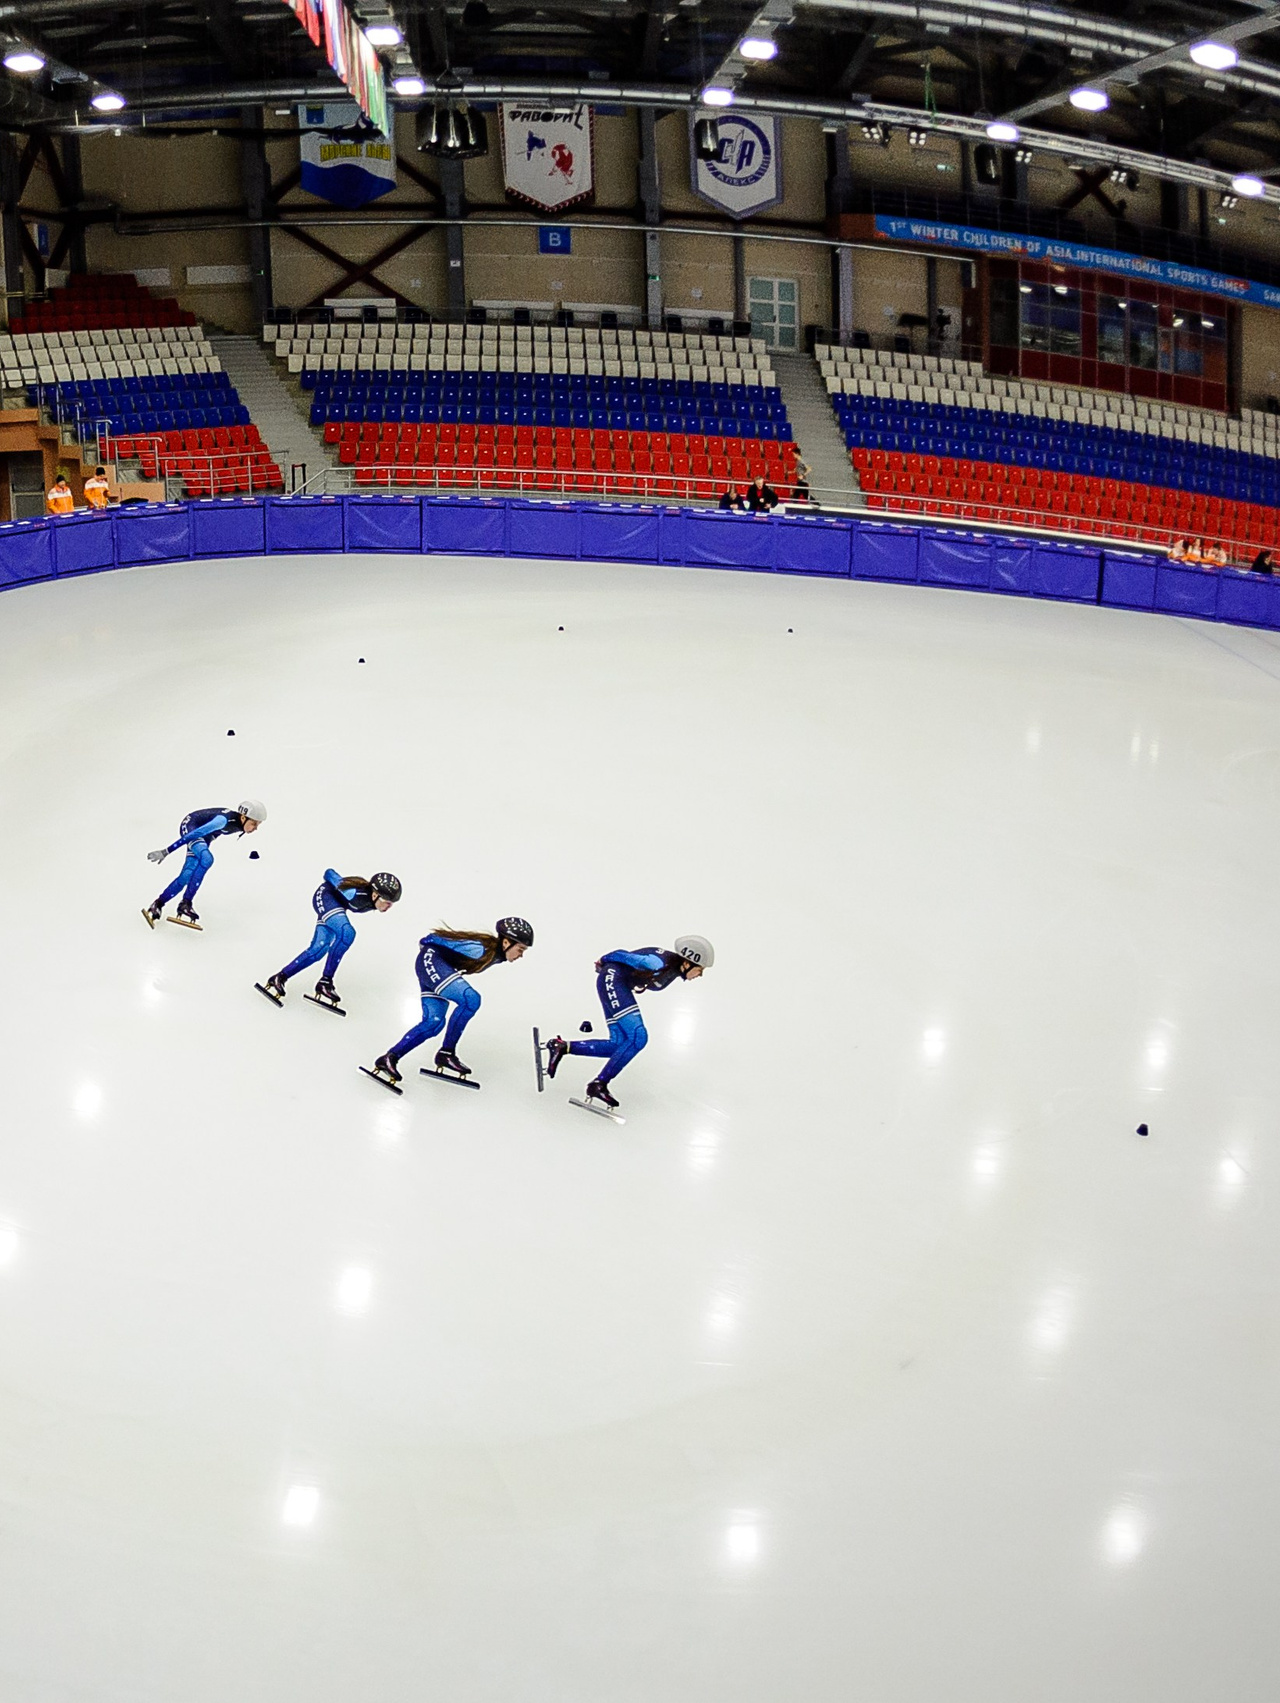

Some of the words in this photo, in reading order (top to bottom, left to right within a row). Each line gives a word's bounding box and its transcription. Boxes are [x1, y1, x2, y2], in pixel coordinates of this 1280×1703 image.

[910, 223, 959, 240] WINTER
[963, 231, 1021, 250] CHILDREN
[1026, 240, 1041, 253] OF
[1046, 245, 1071, 259] ASIA
[1075, 250, 1164, 276] INTERNATIONAL
[1167, 267, 1207, 285] SPORTS
[1211, 276, 1246, 294] GAMES
[423, 948, 441, 983] SAKHA
[680, 947, 701, 963] 420
[605, 968, 620, 1009] SAKHA
